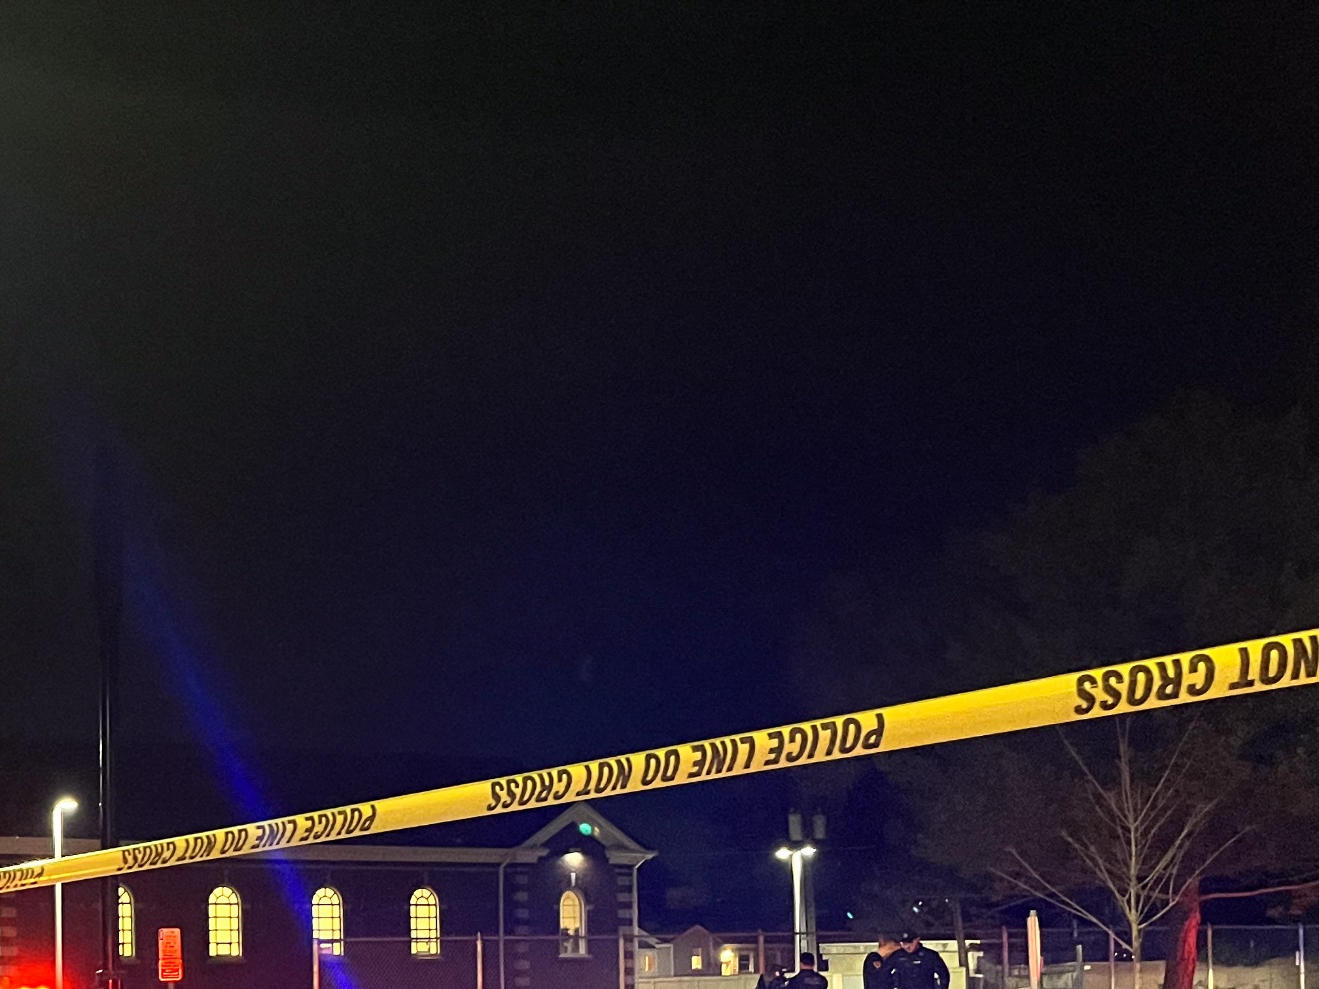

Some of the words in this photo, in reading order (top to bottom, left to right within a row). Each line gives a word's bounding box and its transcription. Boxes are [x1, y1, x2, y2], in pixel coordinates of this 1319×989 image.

[1228, 634, 1319, 691] NOT
[1073, 653, 1216, 716] CROSS
[687, 735, 756, 779] LINE
[763, 712, 886, 767] POLICE
[575, 756, 633, 797] NOT
[641, 748, 681, 786] DO
[486, 768, 573, 812] CROSS
[251, 819, 298, 850] LINE
[299, 804, 378, 842] POLICE
[116, 843, 176, 872] CROSS
[175, 833, 218, 863] NOT
[220, 831, 249, 856] DO
